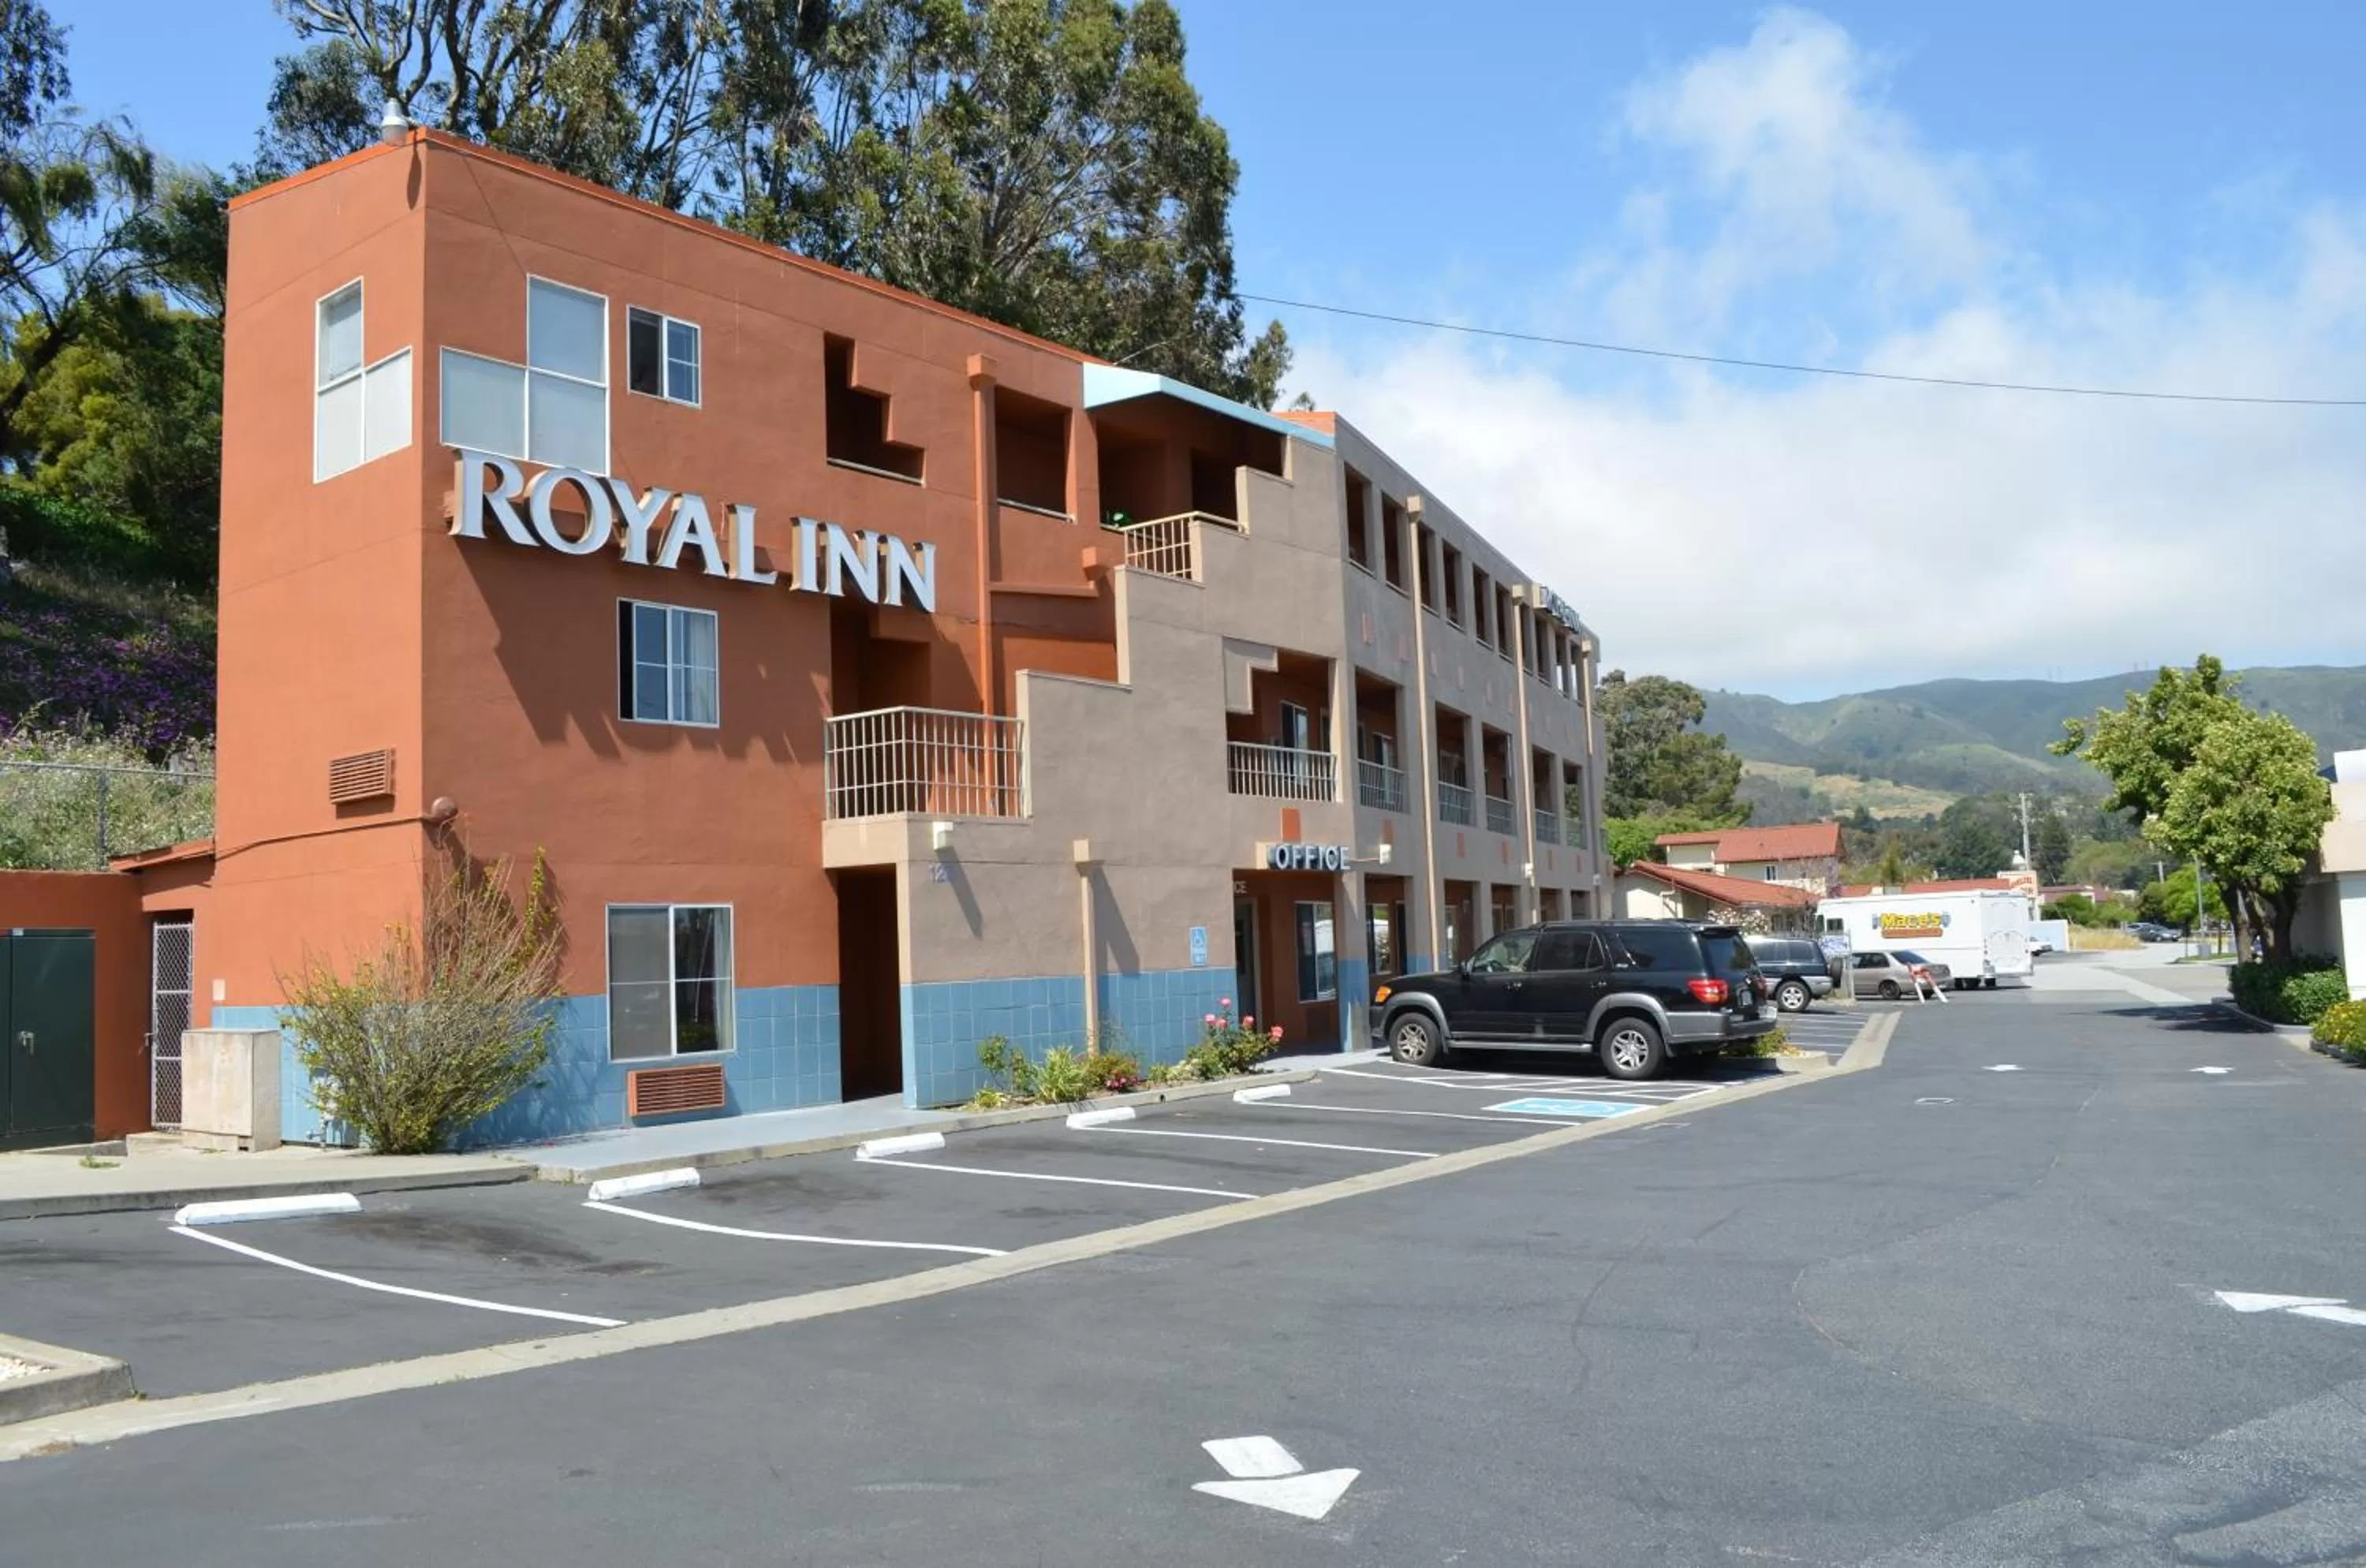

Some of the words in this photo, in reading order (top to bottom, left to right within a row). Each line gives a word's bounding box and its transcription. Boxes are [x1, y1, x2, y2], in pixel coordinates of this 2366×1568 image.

[447, 448, 779, 584] ROYAL
[788, 516, 936, 613] INN
[1271, 844, 1351, 871] OFFICE
